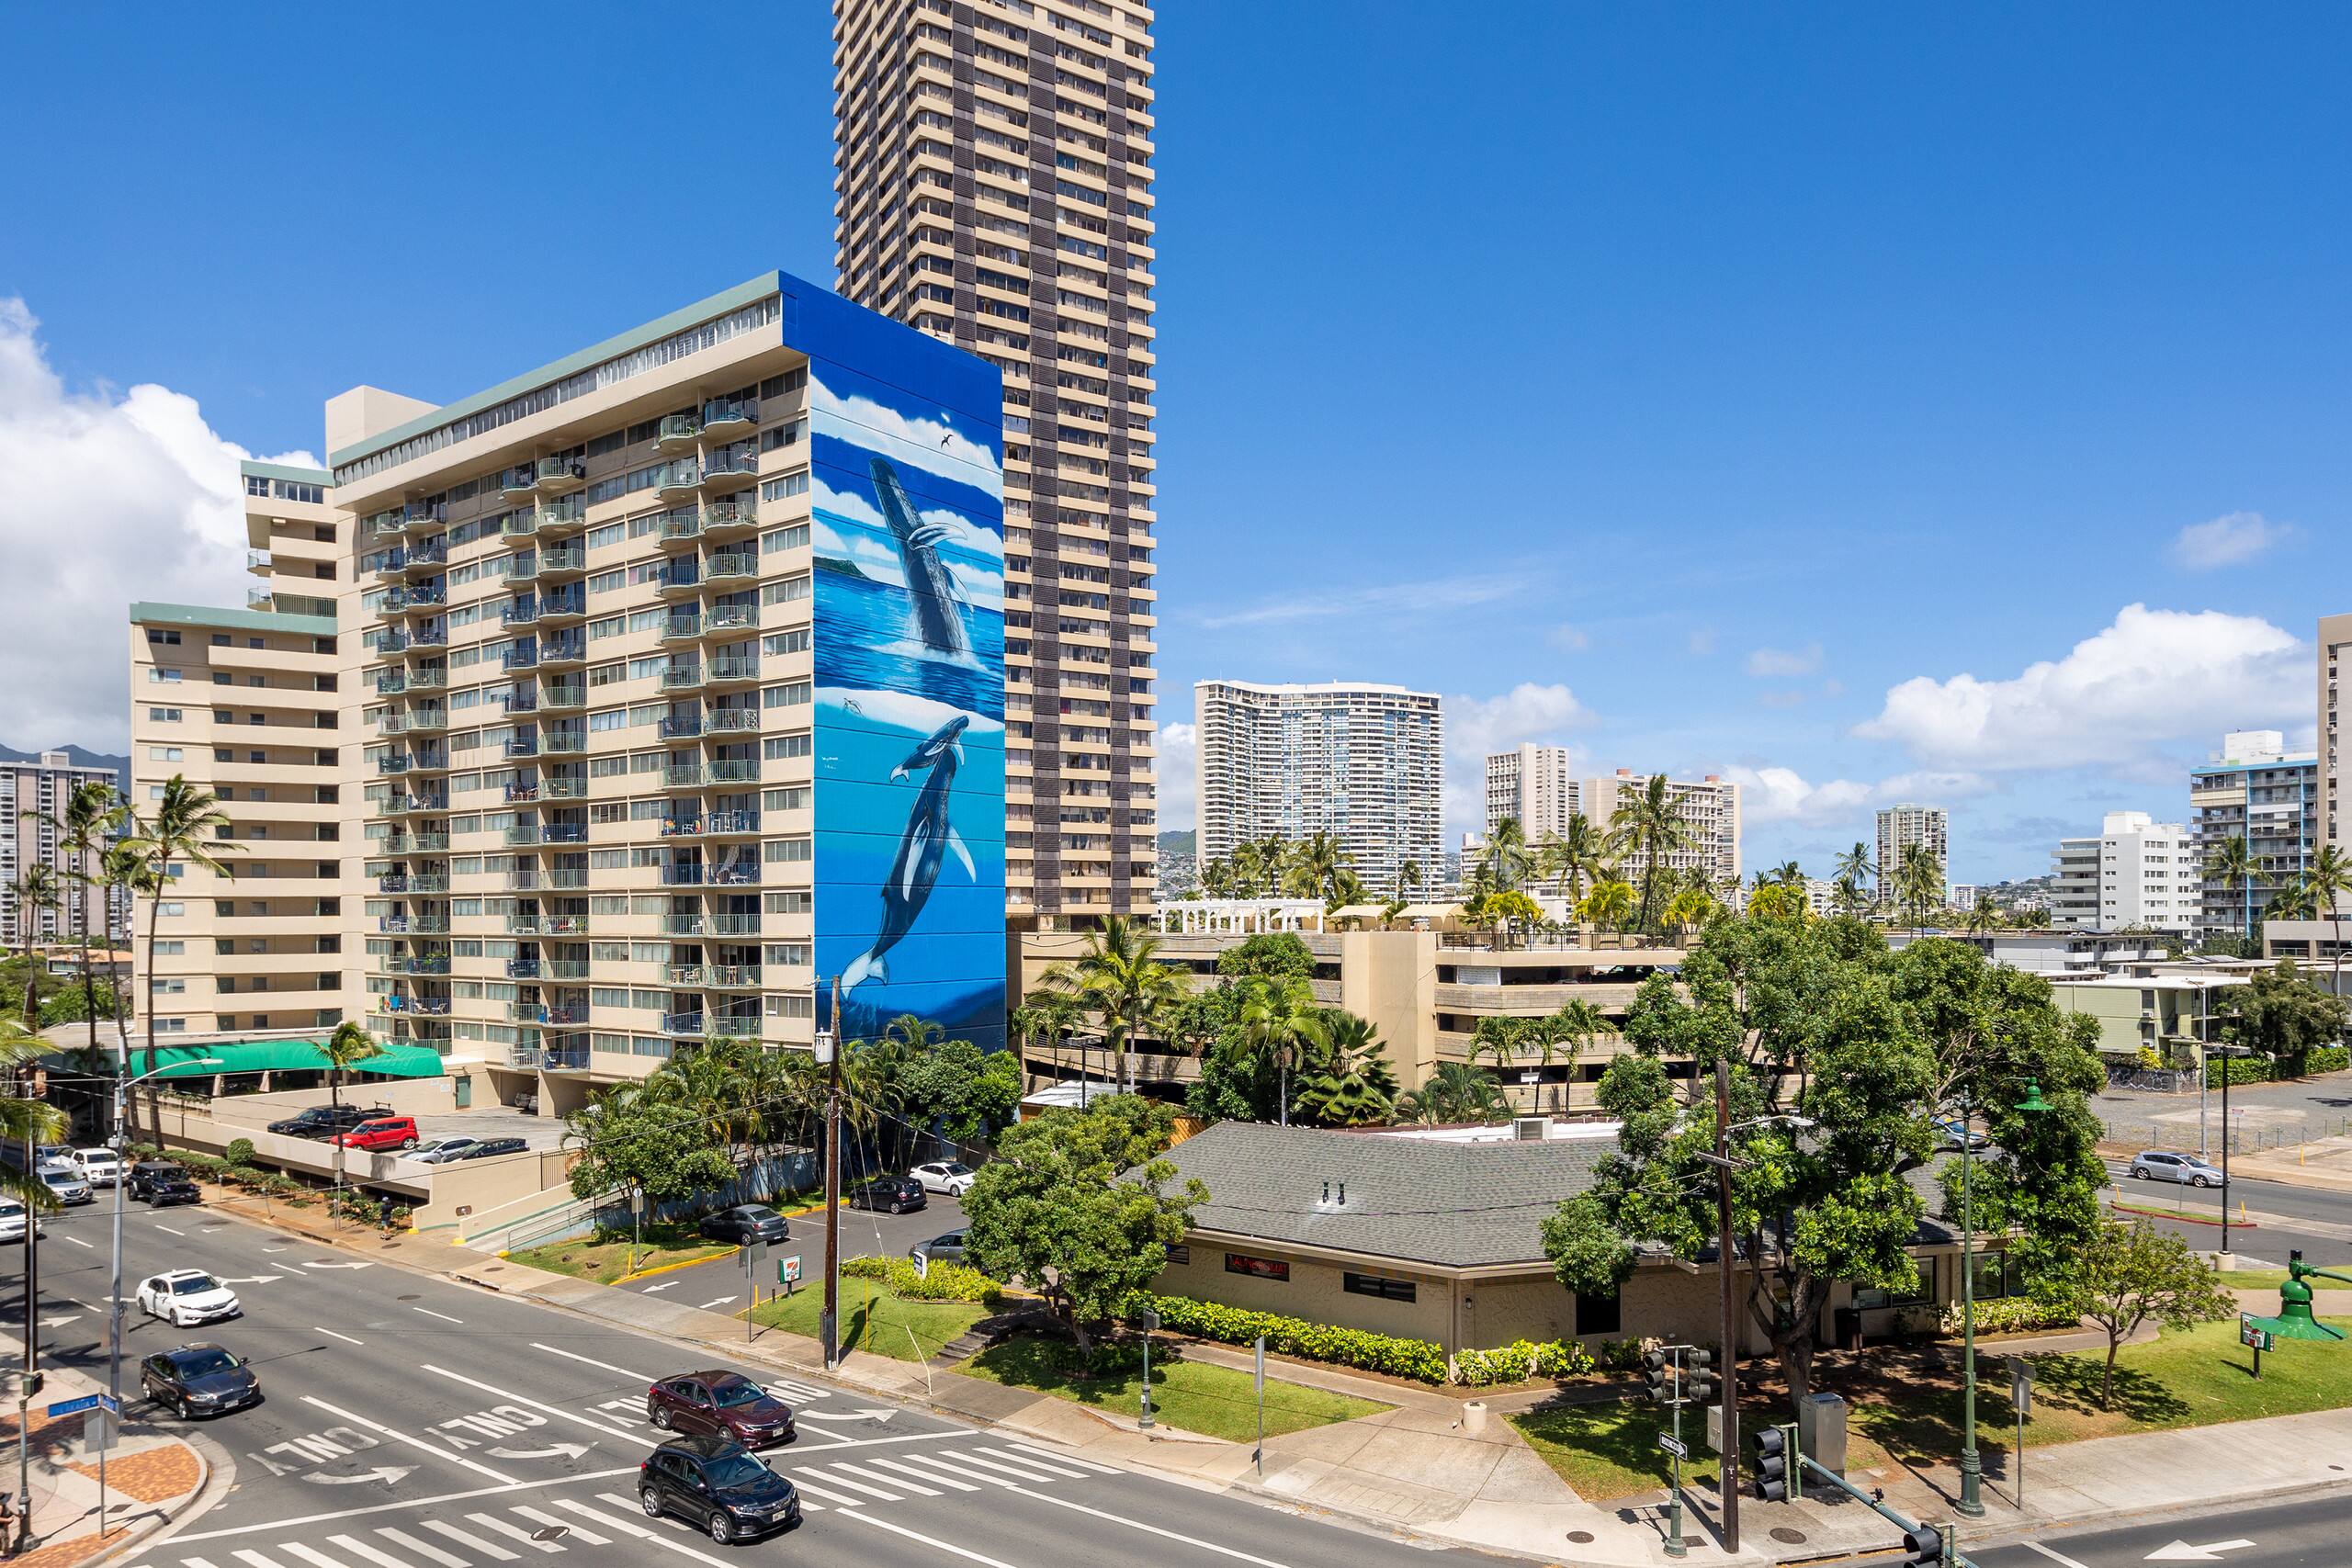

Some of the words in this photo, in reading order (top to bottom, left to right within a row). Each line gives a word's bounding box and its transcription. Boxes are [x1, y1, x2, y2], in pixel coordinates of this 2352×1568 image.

[424, 1405, 548, 1450] ONLY
[1663, 1438, 1671, 1447] ONE
[246, 1427, 379, 1476] ONLY
